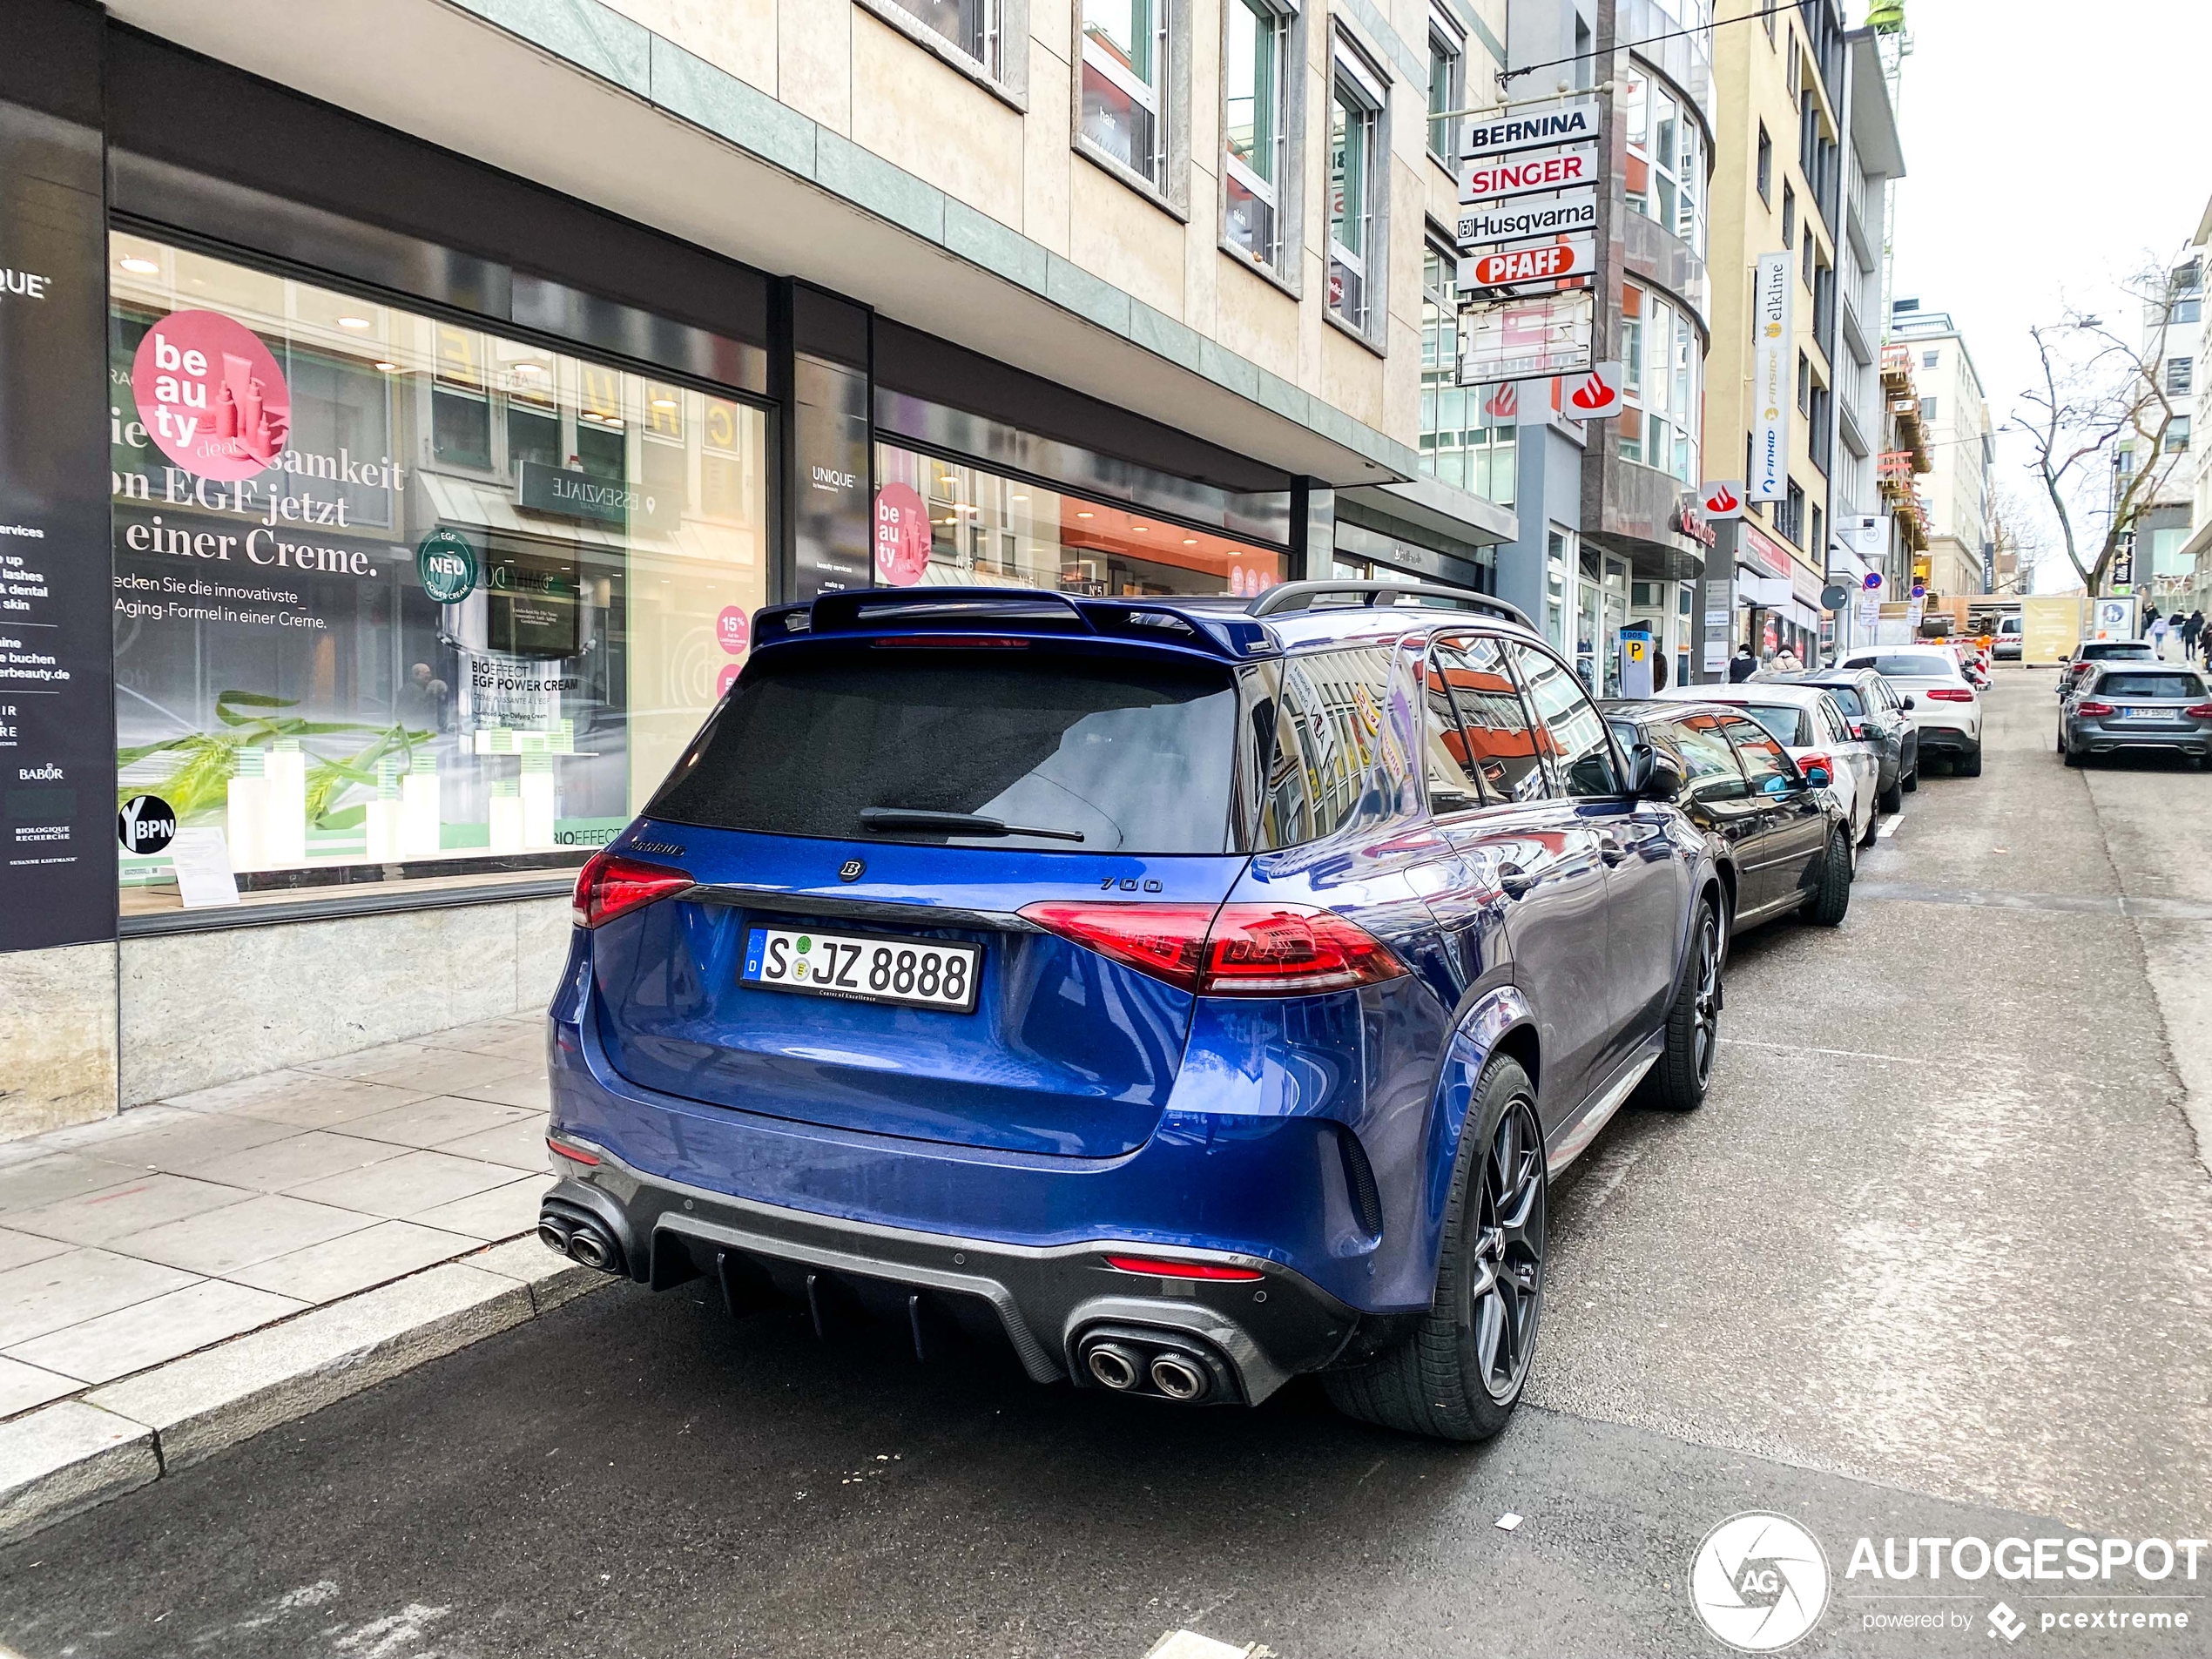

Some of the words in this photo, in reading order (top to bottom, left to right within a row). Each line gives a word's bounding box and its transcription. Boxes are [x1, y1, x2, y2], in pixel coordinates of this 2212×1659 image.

[1099, 106, 1116, 130] hair
[1472, 111, 1587, 147] BERNINA
[1472, 156, 1582, 193] SINGER
[1233, 209, 1246, 226] skin
[1474, 205, 1595, 237] Husqvarna
[1488, 247, 1561, 282] PFAFF
[0, 268, 44, 299] UE
[1767, 264, 1784, 321] elkline
[154, 334, 208, 376] be
[1769, 352, 1778, 405] FINSIDE
[154, 374, 207, 408] au
[154, 403, 199, 448] ty
[197, 436, 238, 459] deal
[1766, 429, 1776, 477] FINKID
[813, 466, 853, 489] UNIQUE
[162, 466, 259, 514] EGF
[261, 484, 350, 528] jetzt
[879, 499, 900, 523] be
[441, 532, 456, 541] EGF
[879, 524, 900, 543] au
[126, 516, 238, 560] einer
[246, 528, 378, 577] Creme.
[879, 542, 895, 568] ty
[6, 554, 24, 566] up
[429, 556, 465, 575] NEU
[3, 569, 44, 583] lashes
[9, 583, 48, 598] dental
[163, 577, 186, 593] Sie
[188, 579, 212, 596] die
[215, 583, 299, 604] innovativste
[426, 581, 448, 599] POWER
[448, 584, 469, 600] CREAM
[3, 598, 30, 611] skin
[225, 608, 237, 622] in
[239, 610, 275, 624] einer
[279, 612, 327, 630] Creme.
[722, 617, 745, 632] 15%
[9, 652, 56, 665] buchen
[1631, 643, 1642, 658] P
[472, 661, 529, 678] BIOEFFECT
[472, 675, 495, 688] EGF
[497, 678, 542, 691] POWER
[543, 678, 579, 691] CREAM
[19, 767, 64, 780] BABOR
[16, 833, 71, 842] RECHERCHE
[1100, 876, 1164, 894] 700
[748, 959, 757, 972] D
[765, 937, 790, 980] S
[813, 942, 862, 988] JZ
[869, 948, 968, 1001] 8888
